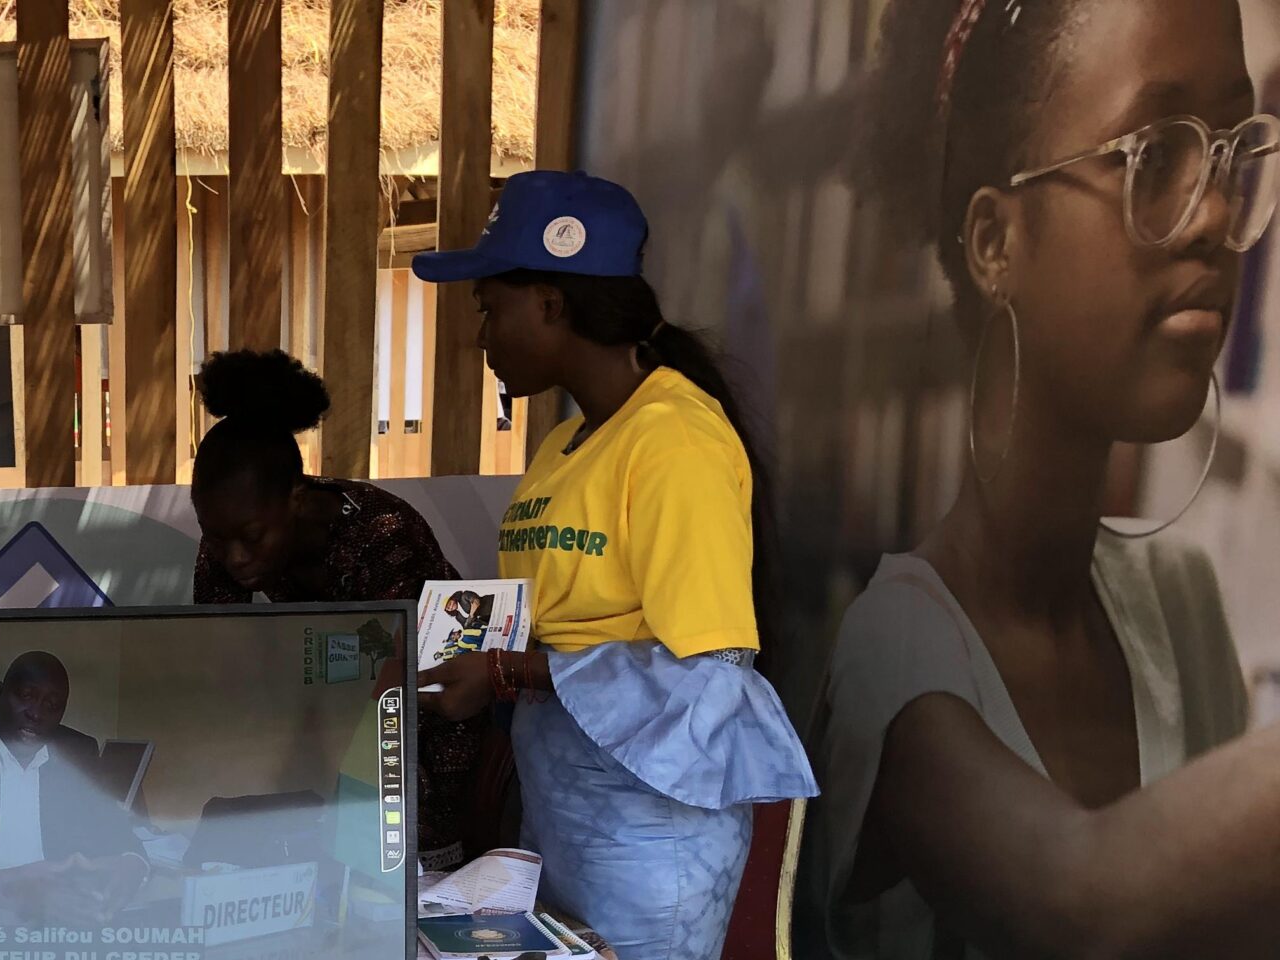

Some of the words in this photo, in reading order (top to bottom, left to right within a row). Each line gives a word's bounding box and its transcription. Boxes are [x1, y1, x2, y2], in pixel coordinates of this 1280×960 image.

[203, 890, 306, 930] DIRECTEUR
[14, 927, 93, 944] Salifou
[100, 927, 205, 944] SOUMAH
